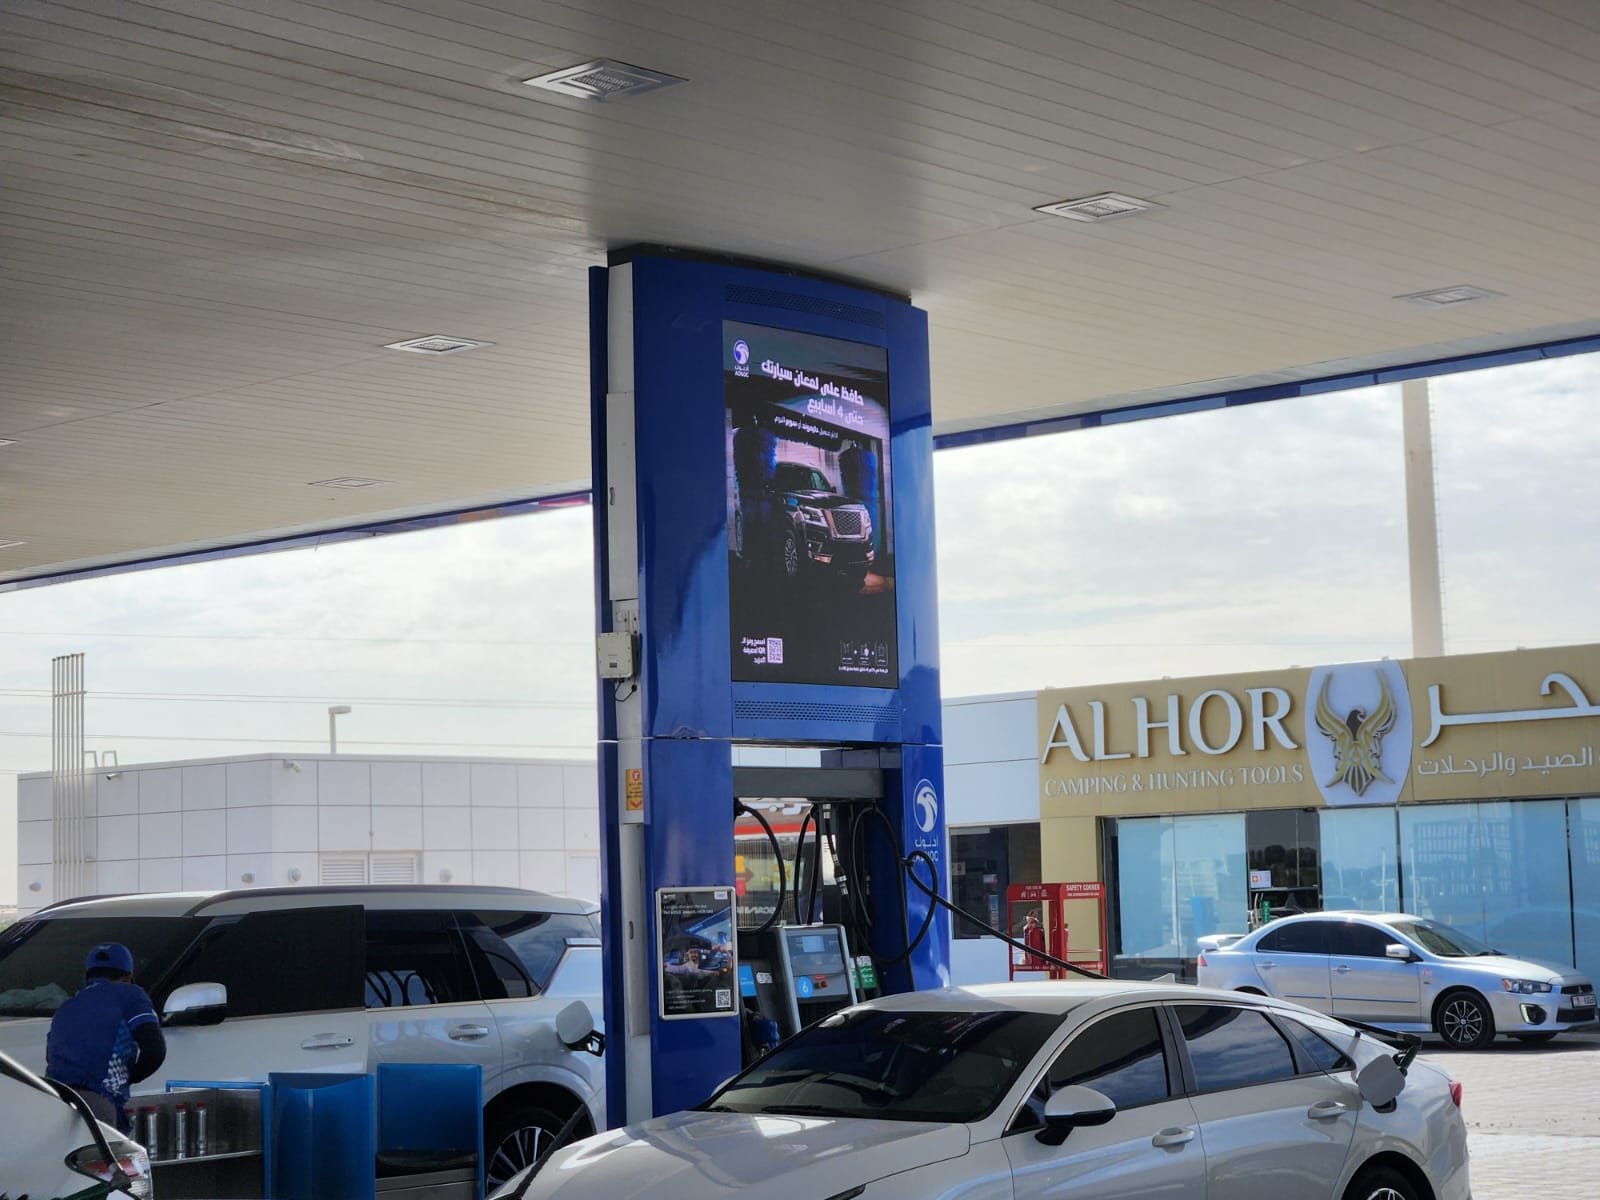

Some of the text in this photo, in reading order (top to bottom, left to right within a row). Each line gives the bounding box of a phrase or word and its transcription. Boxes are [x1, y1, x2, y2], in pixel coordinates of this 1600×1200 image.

[761, 358, 864, 406] حافظ على لمعان سيارتك
[807, 397, 836, 418] أسابيع
[844, 408, 864, 426] حتى
[1040, 686, 1300, 765] ALHOR
[1417, 745, 1593, 777] الصيد والرحلات
[1044, 763, 1305, 797] CAMPING & HUNTING TOOLS
[802, 980, 809, 993] 6
